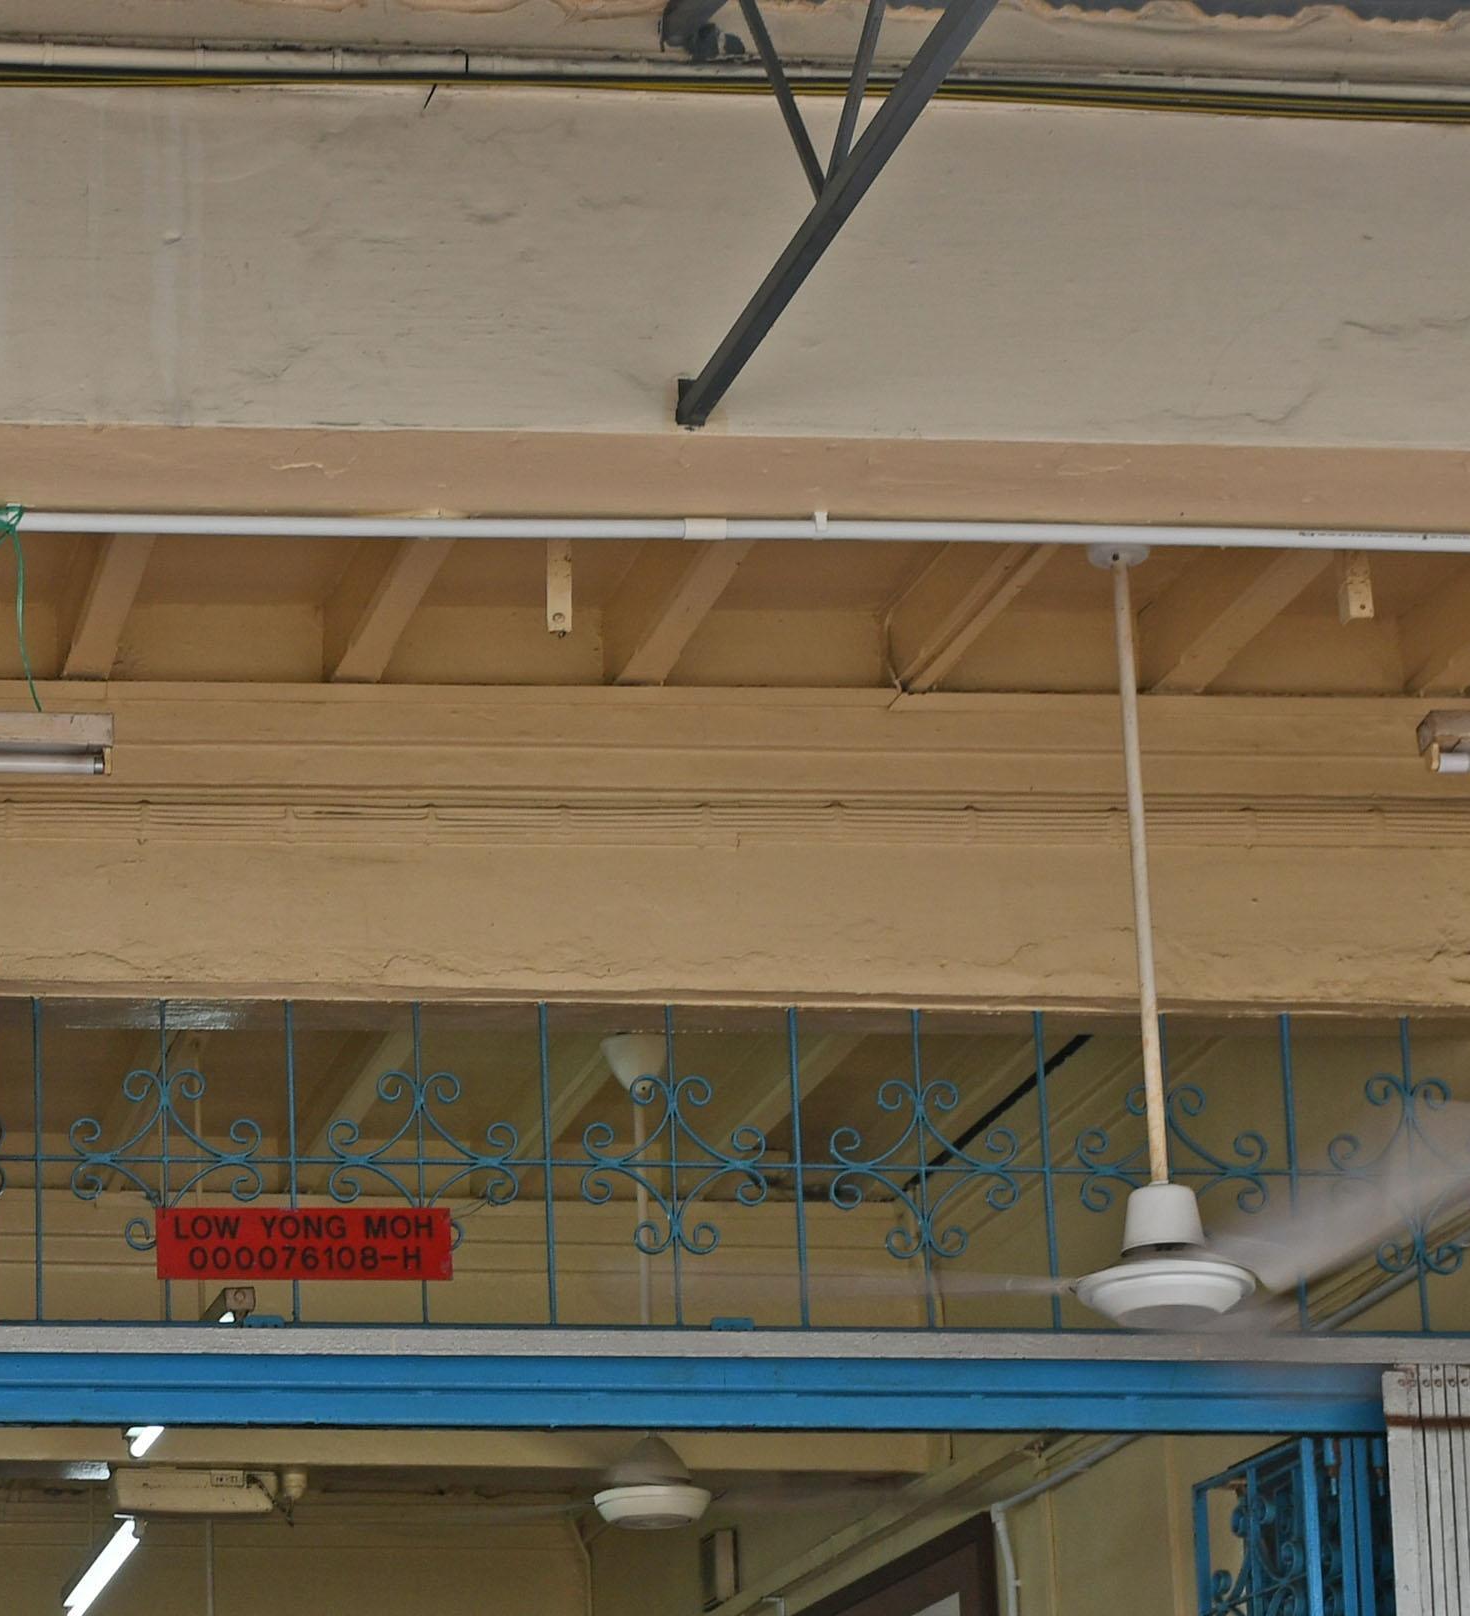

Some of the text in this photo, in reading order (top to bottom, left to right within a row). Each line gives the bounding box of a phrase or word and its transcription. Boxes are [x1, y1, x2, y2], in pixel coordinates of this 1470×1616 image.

[174, 1215, 434, 1240] LOW YONG MOH
[188, 1246, 422, 1270] 000076108-H
